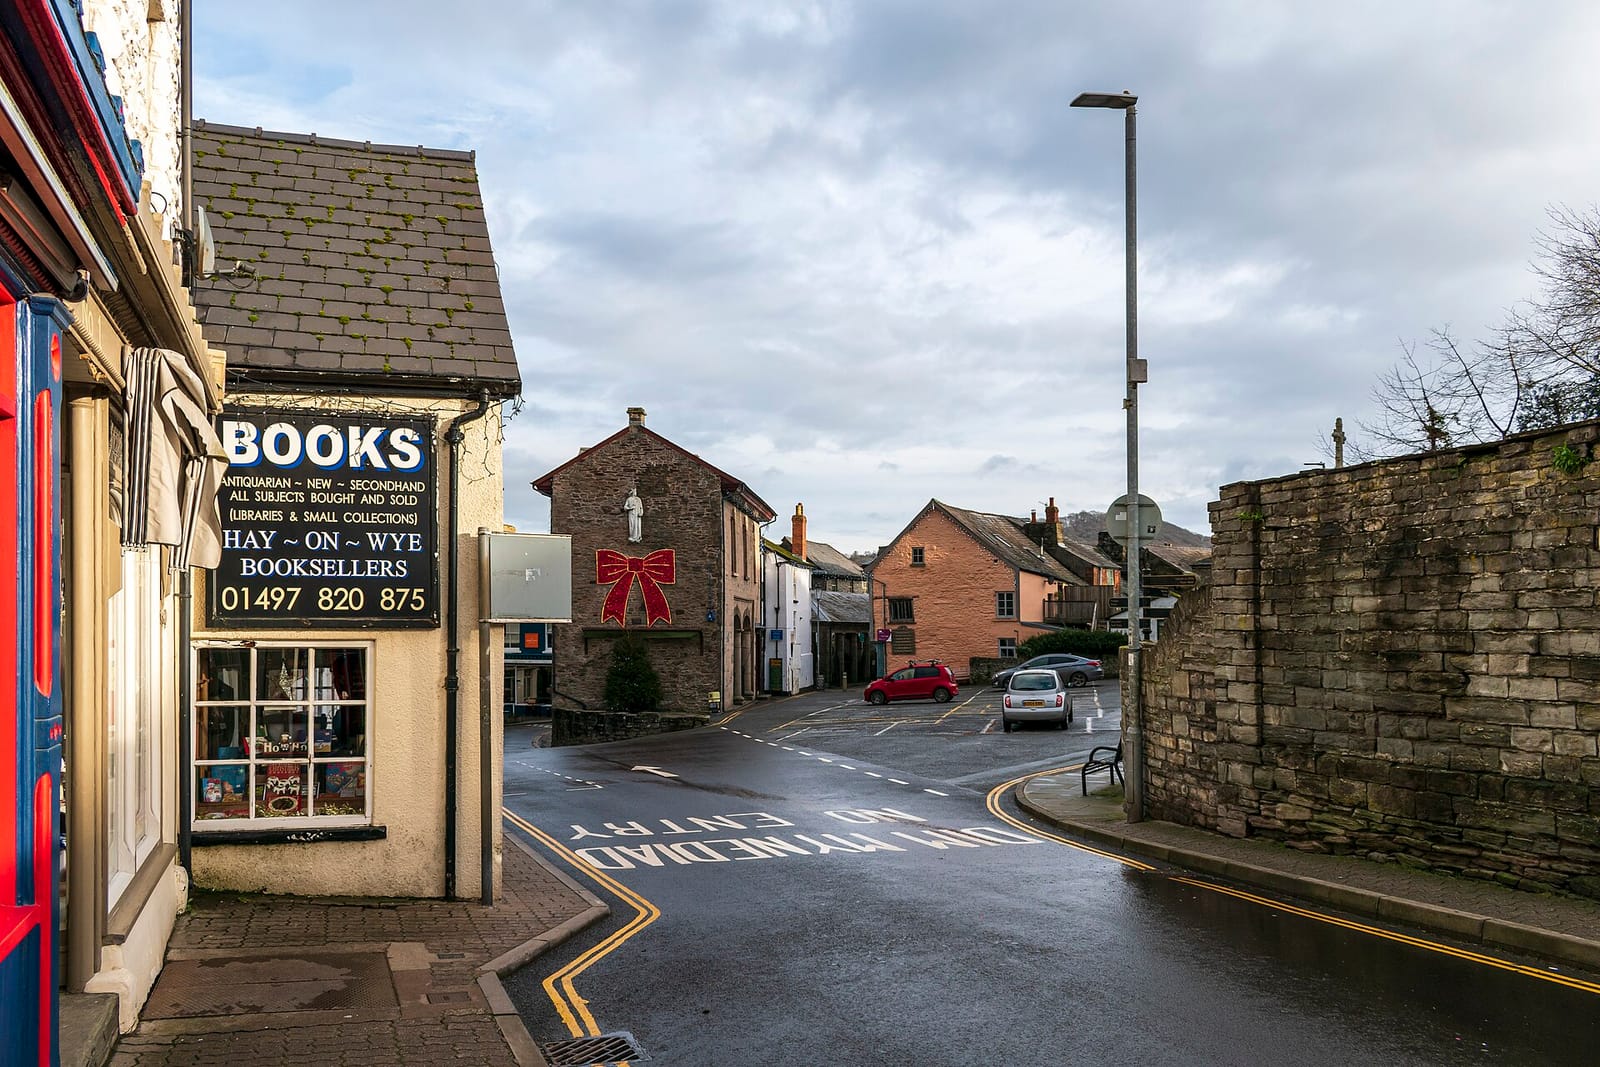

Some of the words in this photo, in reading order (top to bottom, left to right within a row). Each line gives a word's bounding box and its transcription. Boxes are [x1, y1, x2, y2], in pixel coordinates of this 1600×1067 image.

[222, 420, 425, 472] BOOKS
[221, 475, 291, 489] ANTIQUARIAN
[307, 478, 332, 489] NEW
[350, 480, 425, 493] SECONDHAND
[230, 492, 249, 502] ALL
[255, 492, 305, 503] SUBJECTS
[310, 493, 355, 505] BOUGHT
[360, 494, 385, 505] AND
[390, 495, 418, 506] SOLD
[229, 511, 283, 523] (LIBRARIES
[289, 512, 298, 522] &
[304, 512, 338, 523] SMALL
[343, 512, 418, 525] COLLECTIONS)
[222, 530, 277, 550] HAY
[305, 531, 340, 551] ON
[366, 532, 423, 552] WYE
[240, 558, 408, 578] BOOKSELLERS
[221, 586, 302, 611] 01497
[318, 587, 364, 611] 820
[380, 588, 425, 611] 875
[570, 812, 796, 840] ENTRY
[823, 807, 928, 824] NO
[891, 827, 1045, 849] DIM
[574, 833, 908, 870] MYNEDIAD
